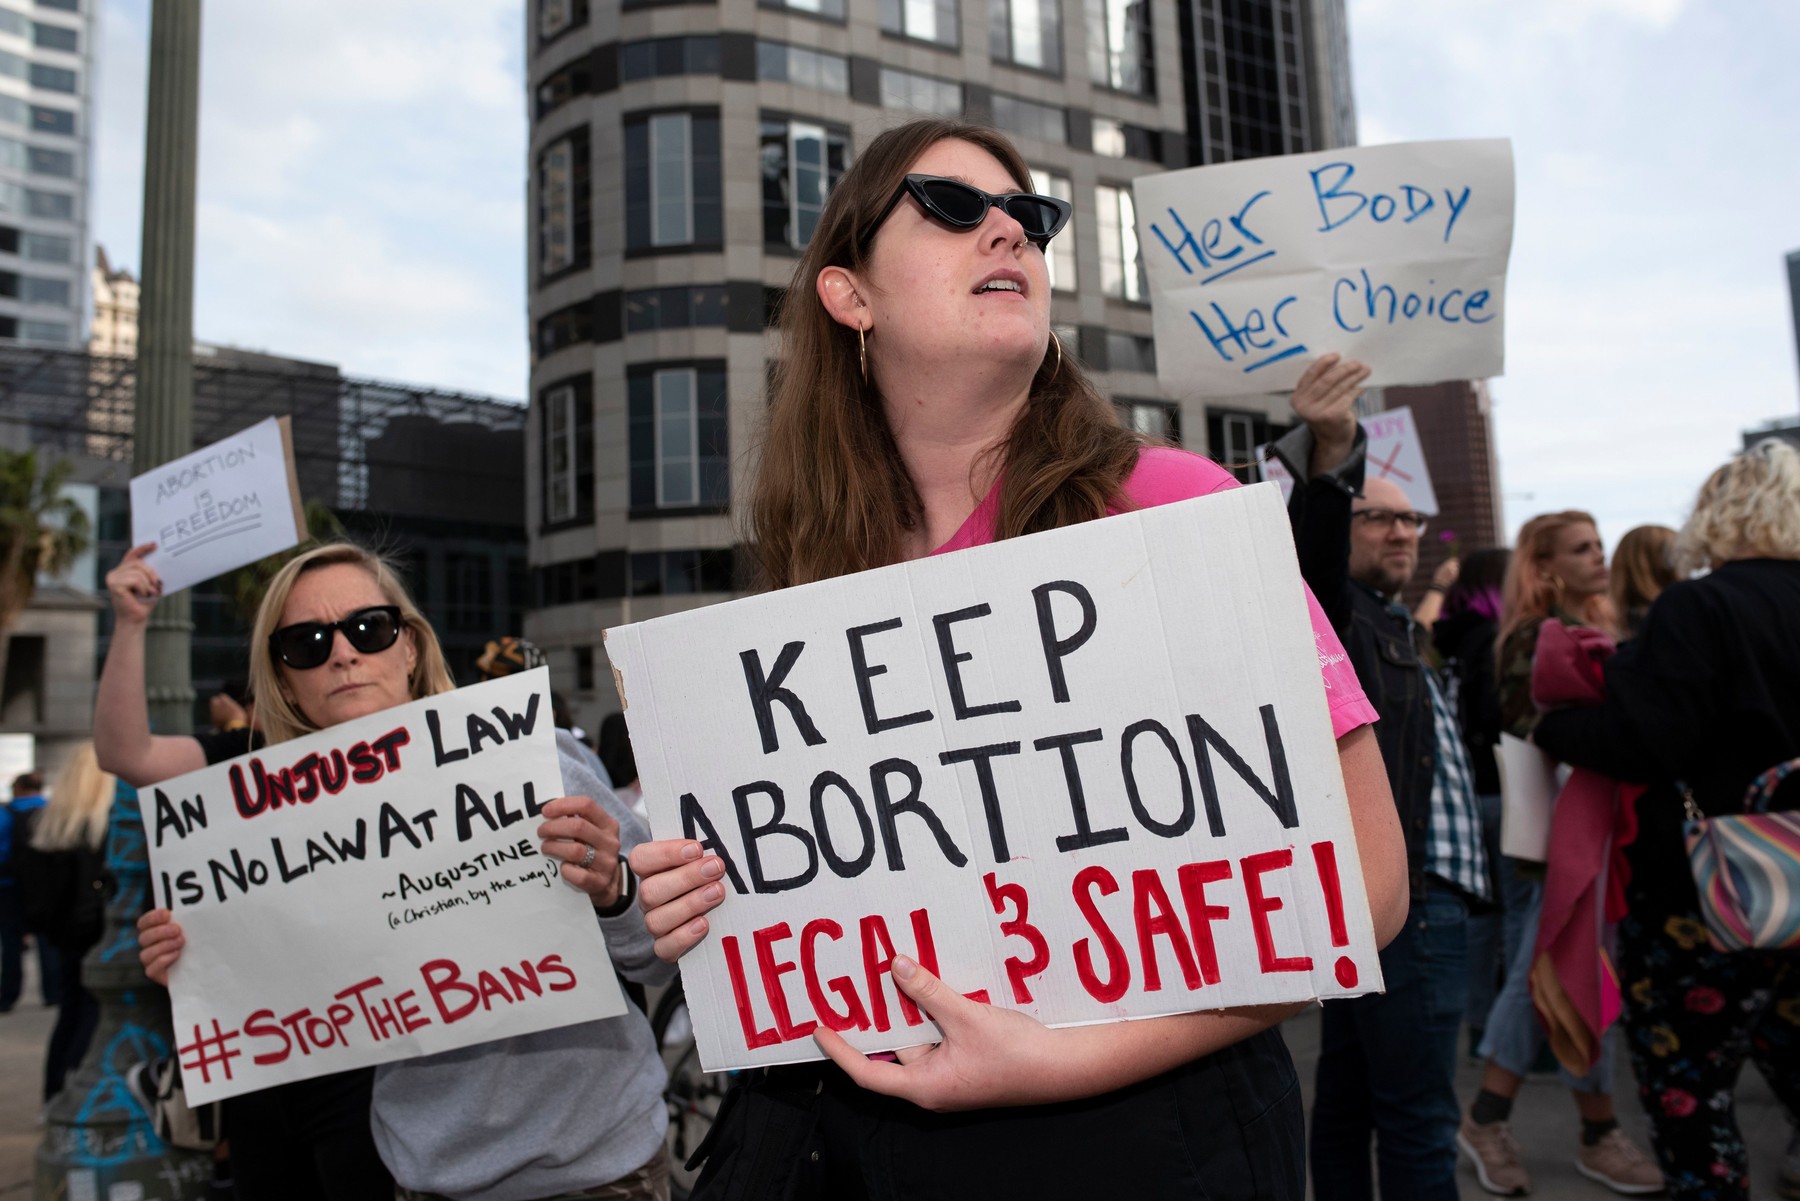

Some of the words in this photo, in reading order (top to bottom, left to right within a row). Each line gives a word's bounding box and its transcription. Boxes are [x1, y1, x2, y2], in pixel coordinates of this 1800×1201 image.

[1151, 191, 1272, 275] Her
[1309, 161, 1471, 242] BODY
[1190, 296, 1297, 361] Her
[1333, 268, 1497, 332] Choice
[155, 441, 256, 505] ABORTION
[159, 492, 262, 545] FREEDOM
[194, 488, 214, 510] IS
[739, 580, 1097, 755] KEEP
[154, 788, 208, 848] AN
[228, 726, 411, 819] UNJUST
[425, 693, 541, 768] LAW
[680, 703, 1300, 895] ABORTION
[161, 869, 204, 909] IS
[270, 818, 367, 884] LAW
[378, 802, 438, 859] AT
[455, 781, 558, 843] ALL
[388, 911, 402, 930] (a
[404, 894, 470, 924] Christian,
[467, 889, 491, 905] by
[489, 878, 517, 893] the
[519, 858, 559, 888] way!)
[722, 908, 990, 1050] LEGAL
[1072, 841, 1358, 1004] SAFE!
